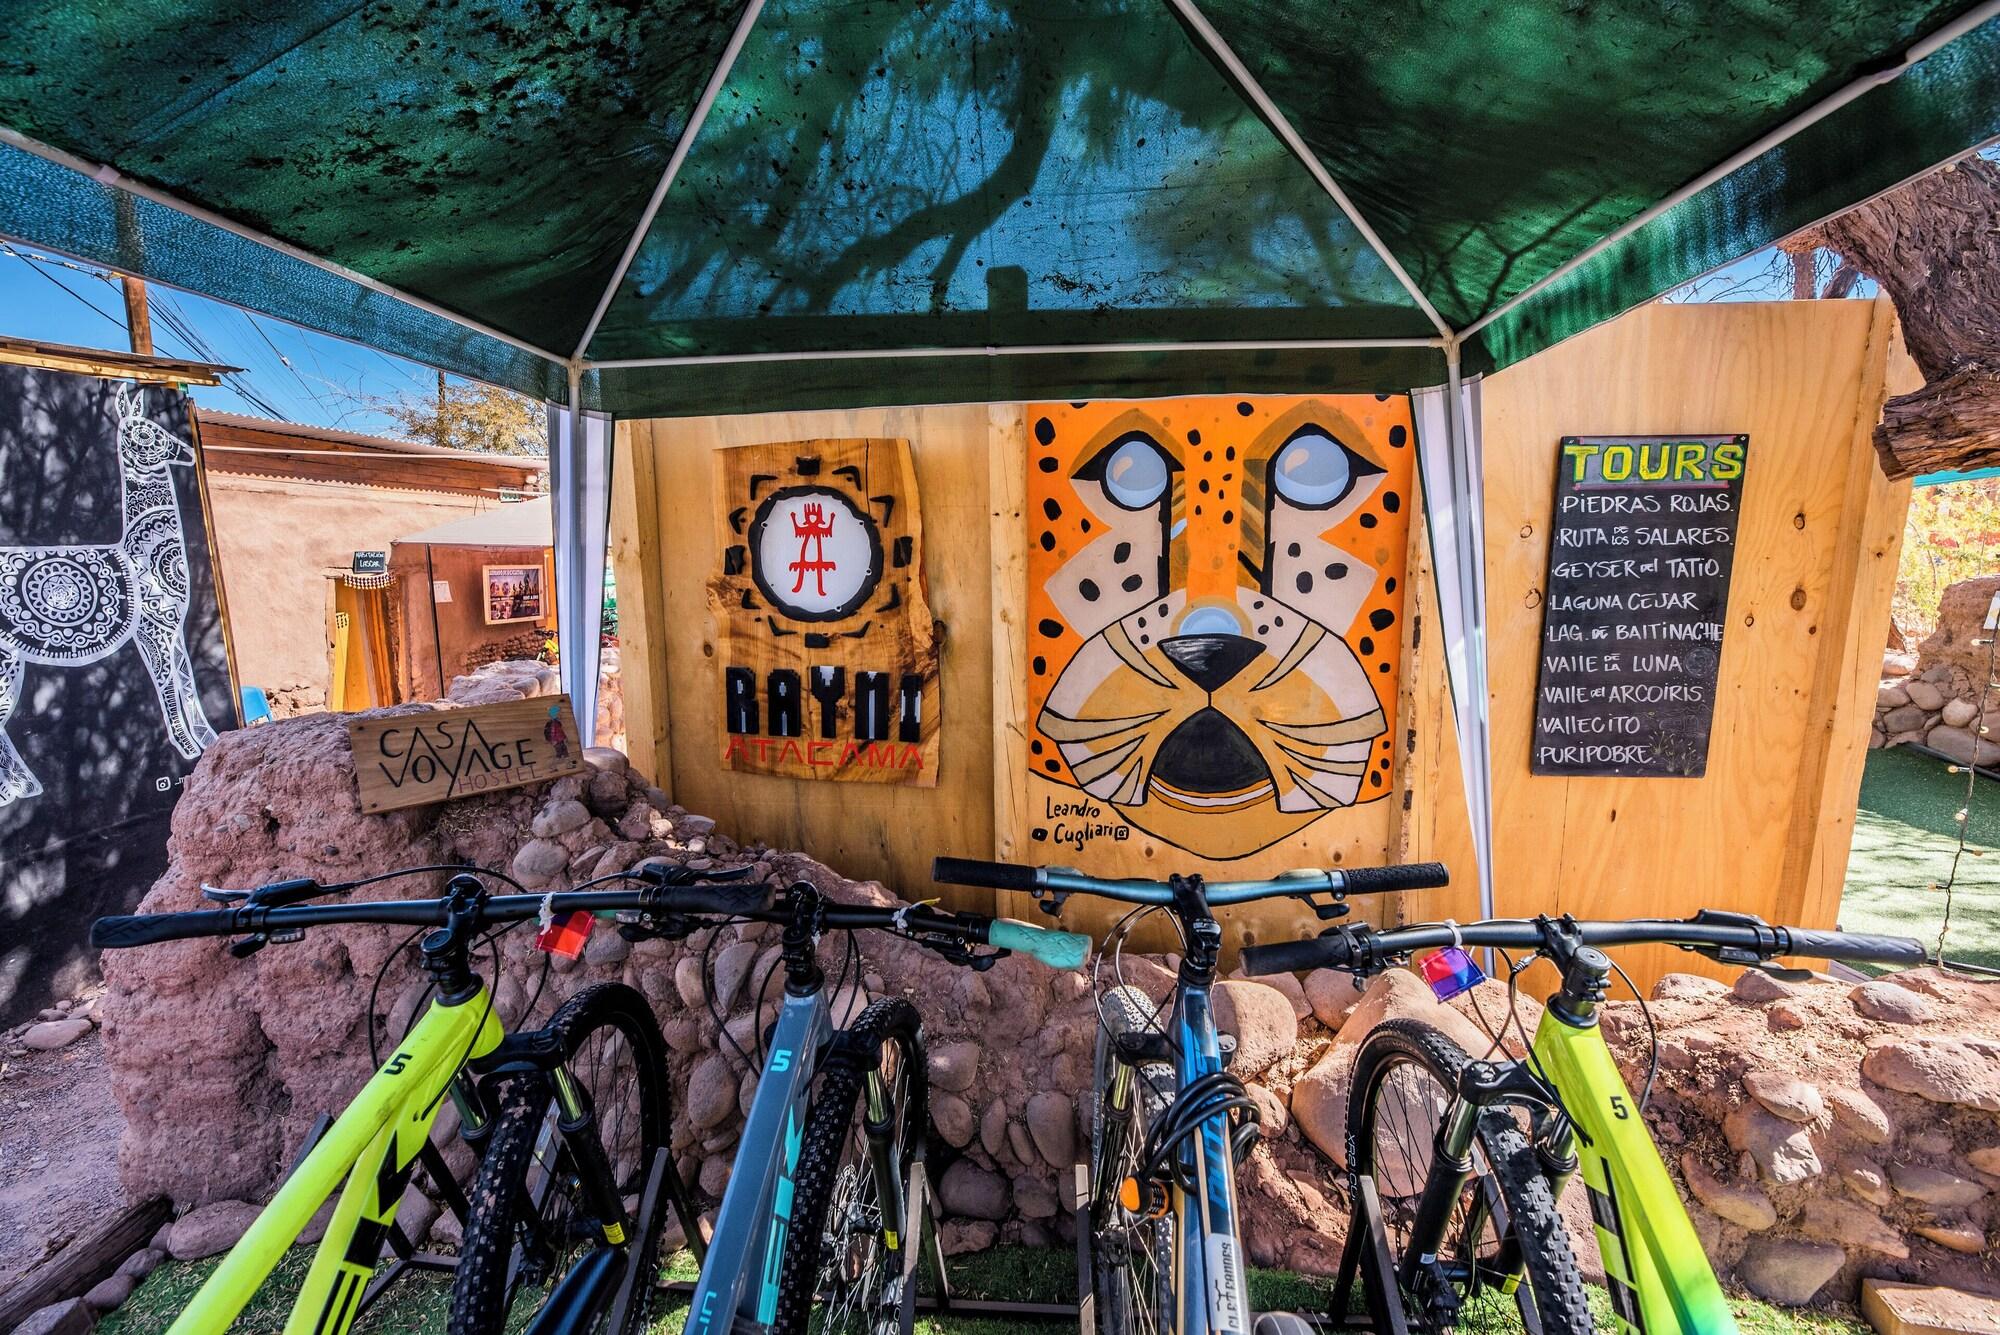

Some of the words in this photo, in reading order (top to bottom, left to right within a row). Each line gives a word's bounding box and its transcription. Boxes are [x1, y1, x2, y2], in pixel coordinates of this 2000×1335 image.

[1563, 442, 1745, 482] TOURS
[1559, 527, 1609, 547] RUTA
[1611, 535, 1630, 546] LOS
[1613, 525, 1629, 534] DE
[1554, 559, 1641, 578] GEYSER
[1551, 594, 1623, 611] LAGUNA
[1627, 592, 1700, 611] CEJAR
[1549, 623, 1589, 642] LAG.
[1604, 653, 1621, 661] DE
[1604, 663, 1621, 672] LA
[1632, 654, 1683, 673] LUNA
[726, 666, 922, 743] RAYMI
[379, 719, 492, 760] CASA
[724, 735, 924, 770] ATACAMA
[378, 739, 537, 798] VOYAGE
[457, 764, 544, 794] HOSTEL
[1046, 796, 1101, 819] Leandro
[1054, 822, 1113, 851] Cugliari
[384, 1053, 413, 1075] 5
[769, 1049, 793, 1072] 5
[1610, 1095, 1629, 1120] 5
